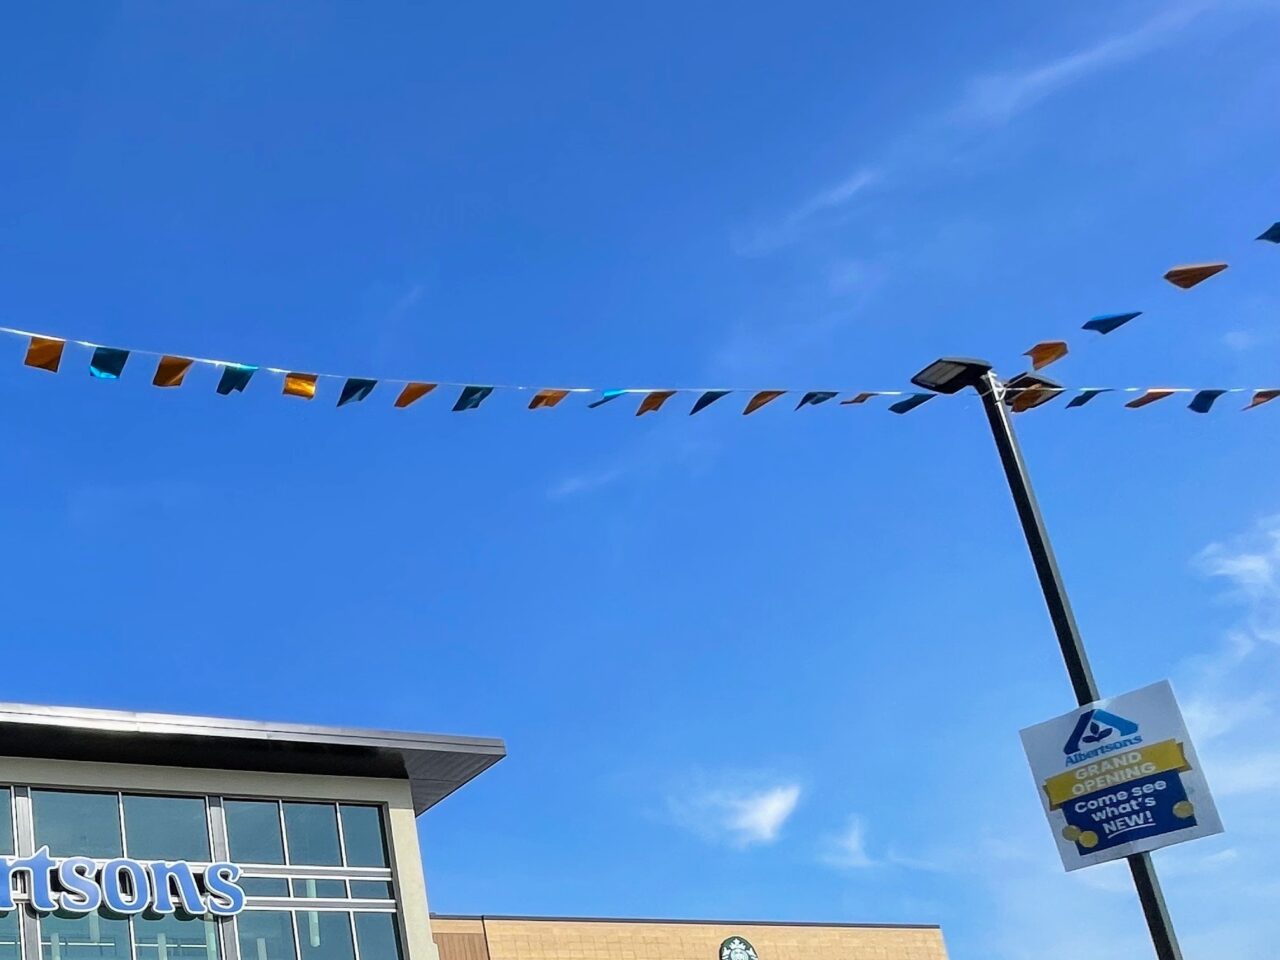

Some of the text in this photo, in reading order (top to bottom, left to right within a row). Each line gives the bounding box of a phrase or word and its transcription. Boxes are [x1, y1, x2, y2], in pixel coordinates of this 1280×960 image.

[1065, 735, 1143, 767] Albertsons
[1075, 752, 1141, 779] GRAND
[1072, 762, 1156, 795] OPENING
[1074, 780, 1167, 813] Come see
[1091, 797, 1156, 822] what's
[1102, 811, 1153, 834] NEW!
